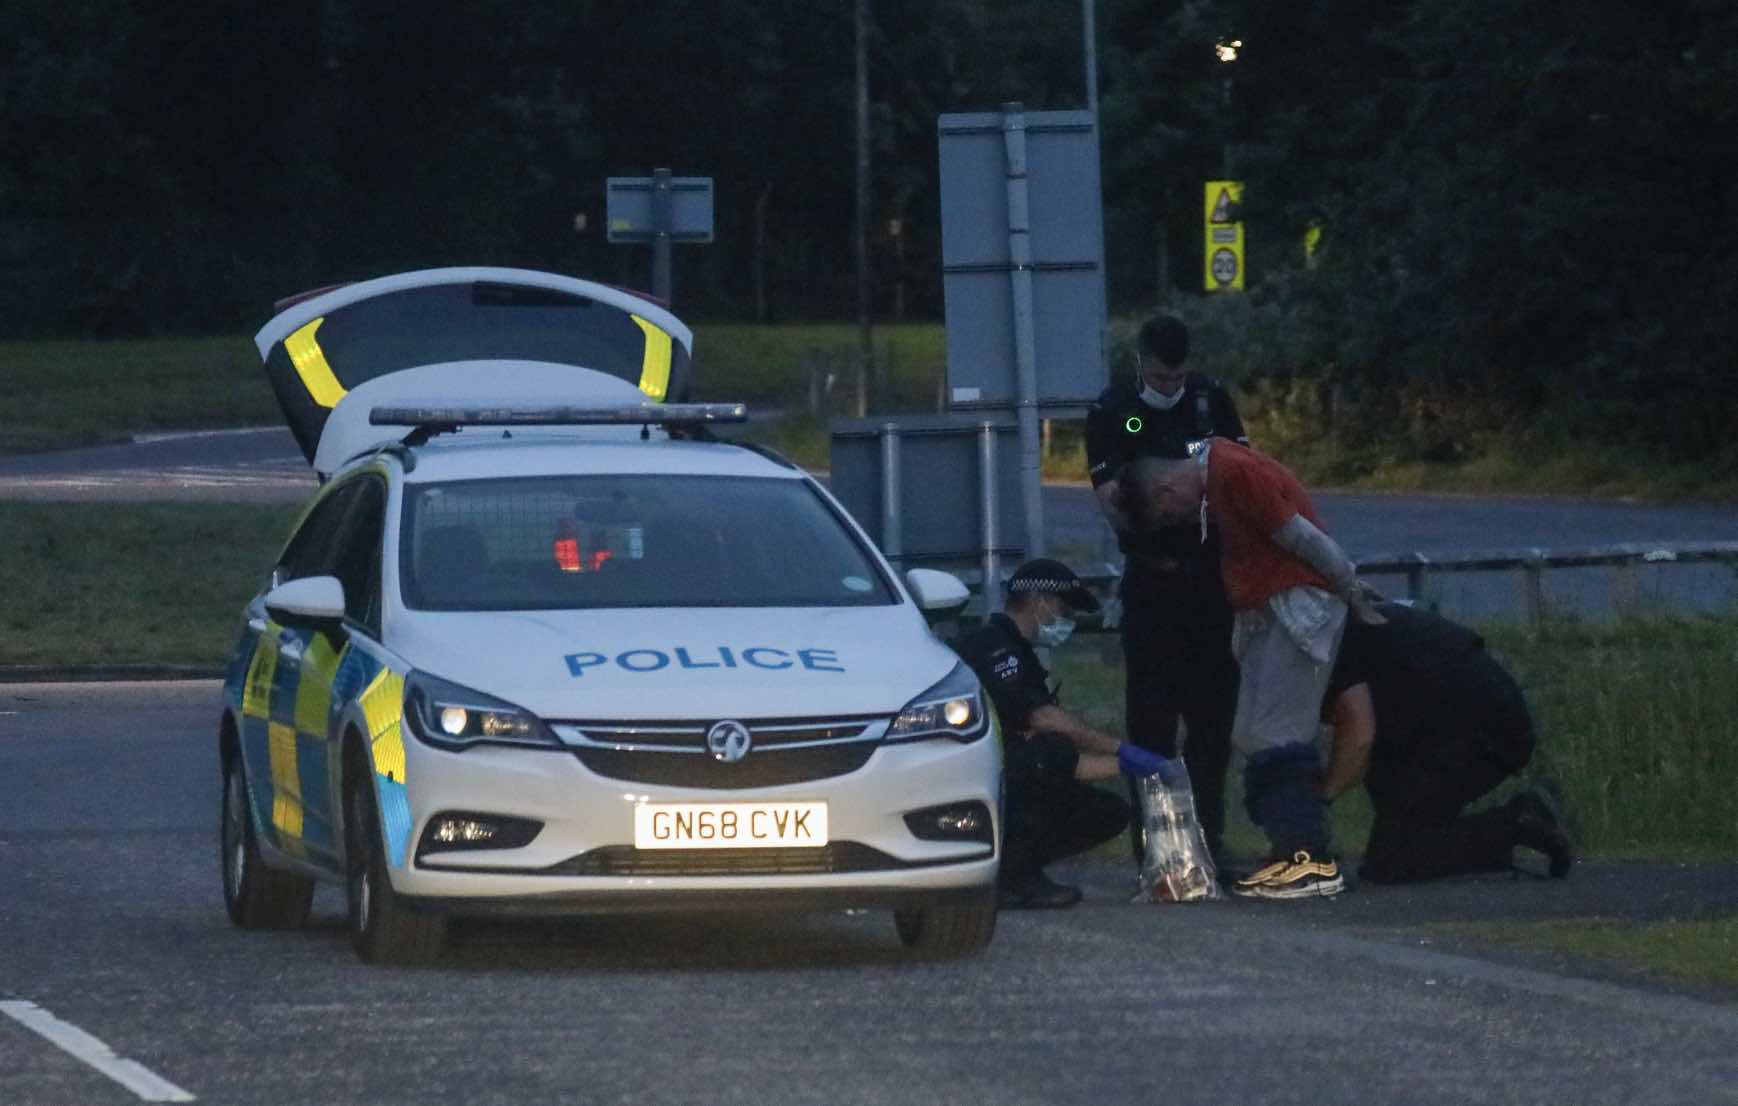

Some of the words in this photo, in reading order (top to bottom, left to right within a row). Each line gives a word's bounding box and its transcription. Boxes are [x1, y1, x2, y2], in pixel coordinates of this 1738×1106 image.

[564, 647, 845, 677] POLICE
[653, 811, 738, 839] GN68
[751, 810, 811, 838] CVK
